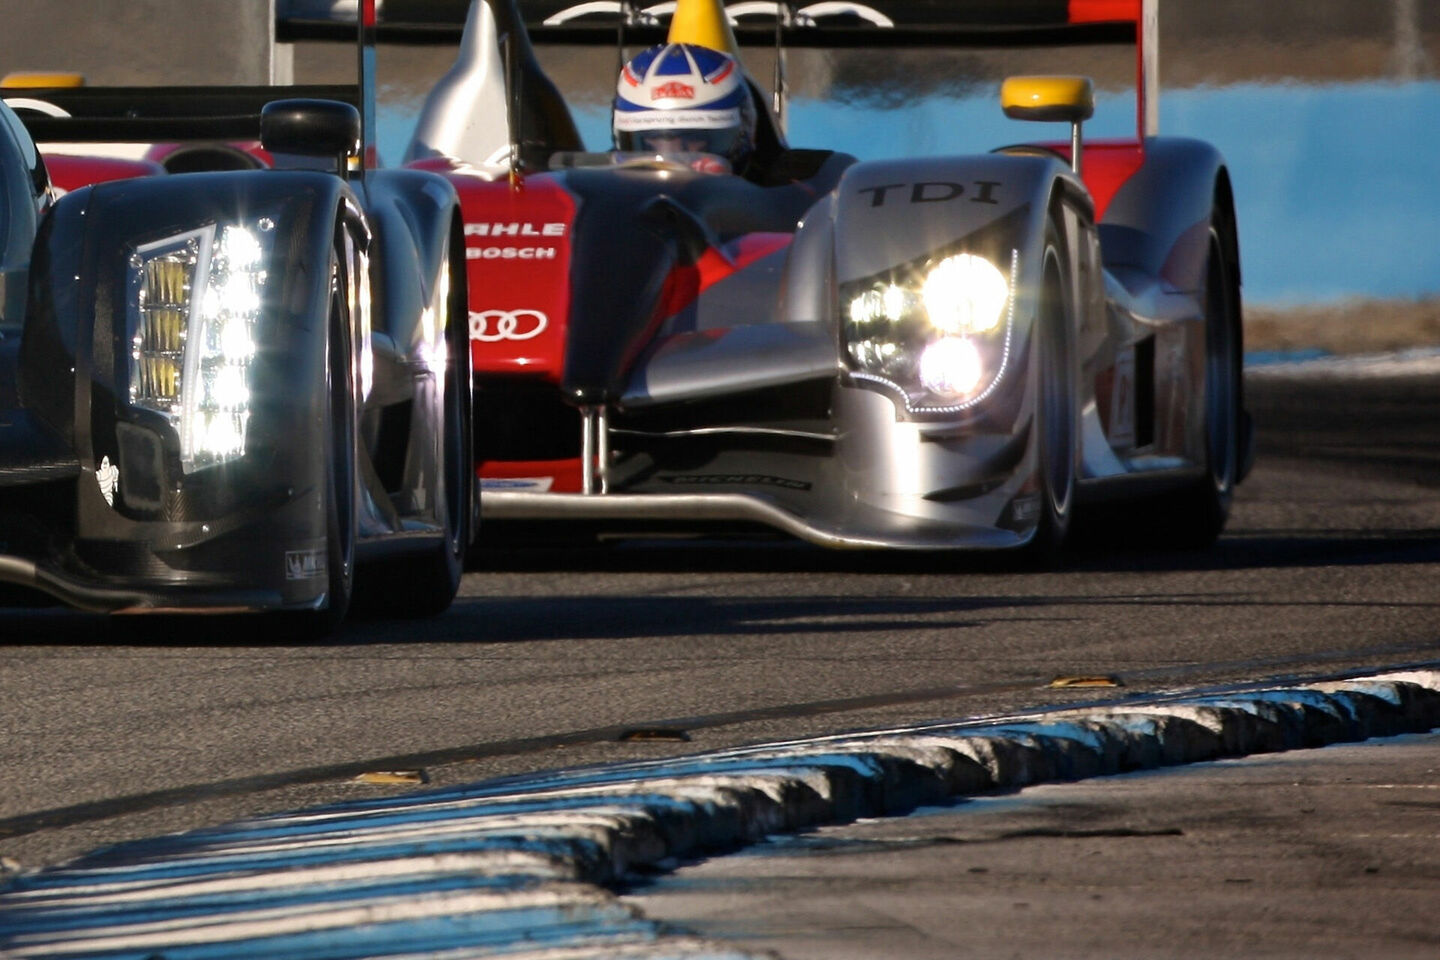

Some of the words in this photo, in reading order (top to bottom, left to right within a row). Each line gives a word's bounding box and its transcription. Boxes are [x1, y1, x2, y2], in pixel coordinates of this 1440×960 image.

[858, 181, 1002, 207] TDI
[464, 223, 566, 236] AHLE
[466, 247, 556, 259] BOSCH
